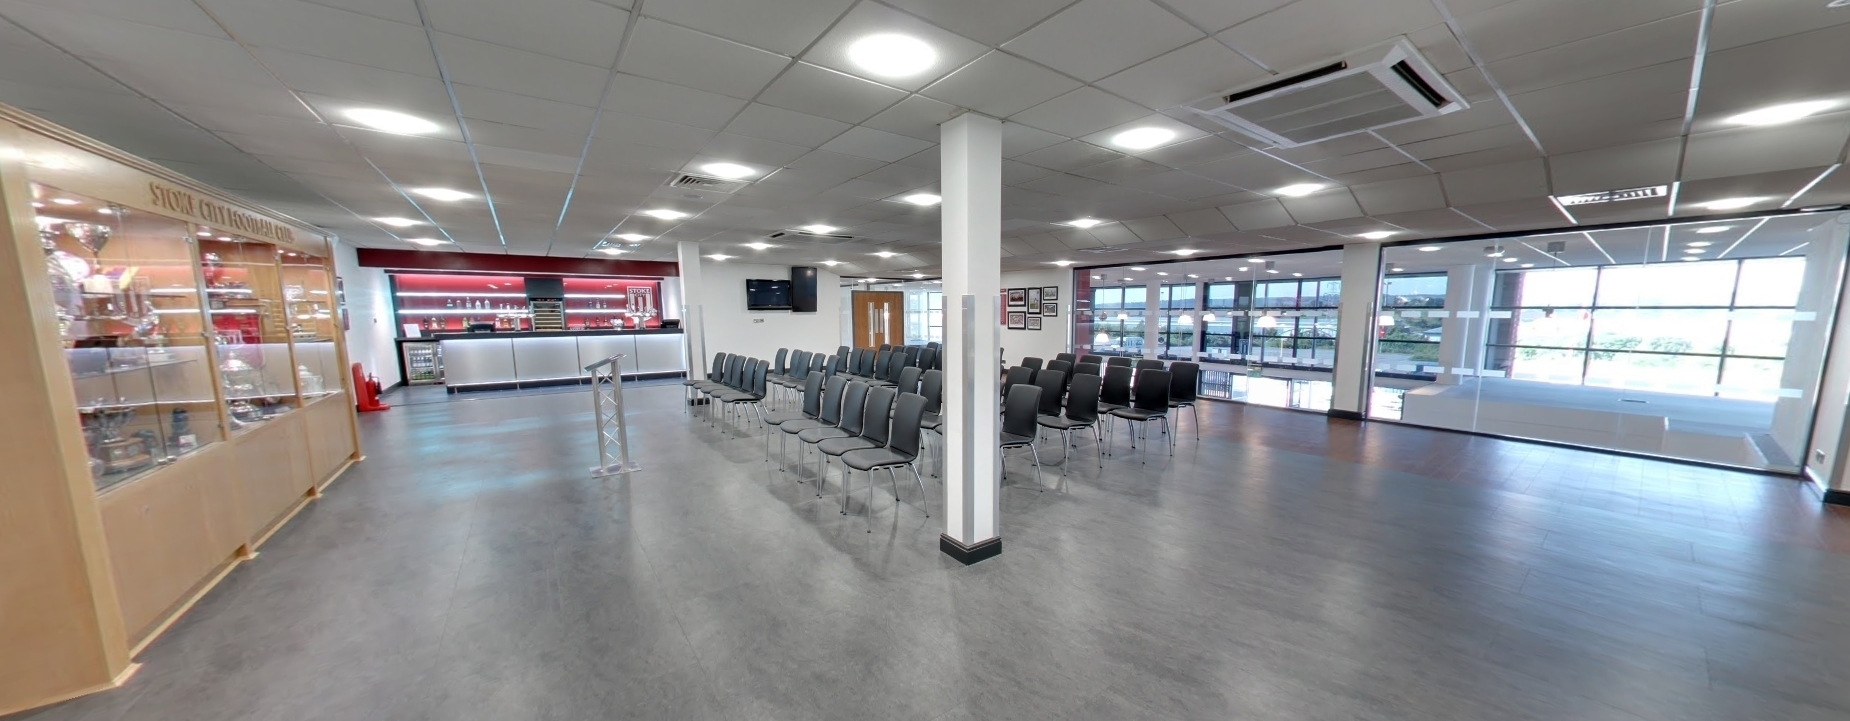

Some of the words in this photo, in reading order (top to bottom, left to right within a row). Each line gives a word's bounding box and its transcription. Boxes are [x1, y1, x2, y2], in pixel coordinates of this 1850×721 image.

[149, 181, 196, 217] STOKE
[199, 199, 227, 225] CITY
[227, 207, 275, 239] FOOTBALL
[275, 224, 295, 244] CLUB
